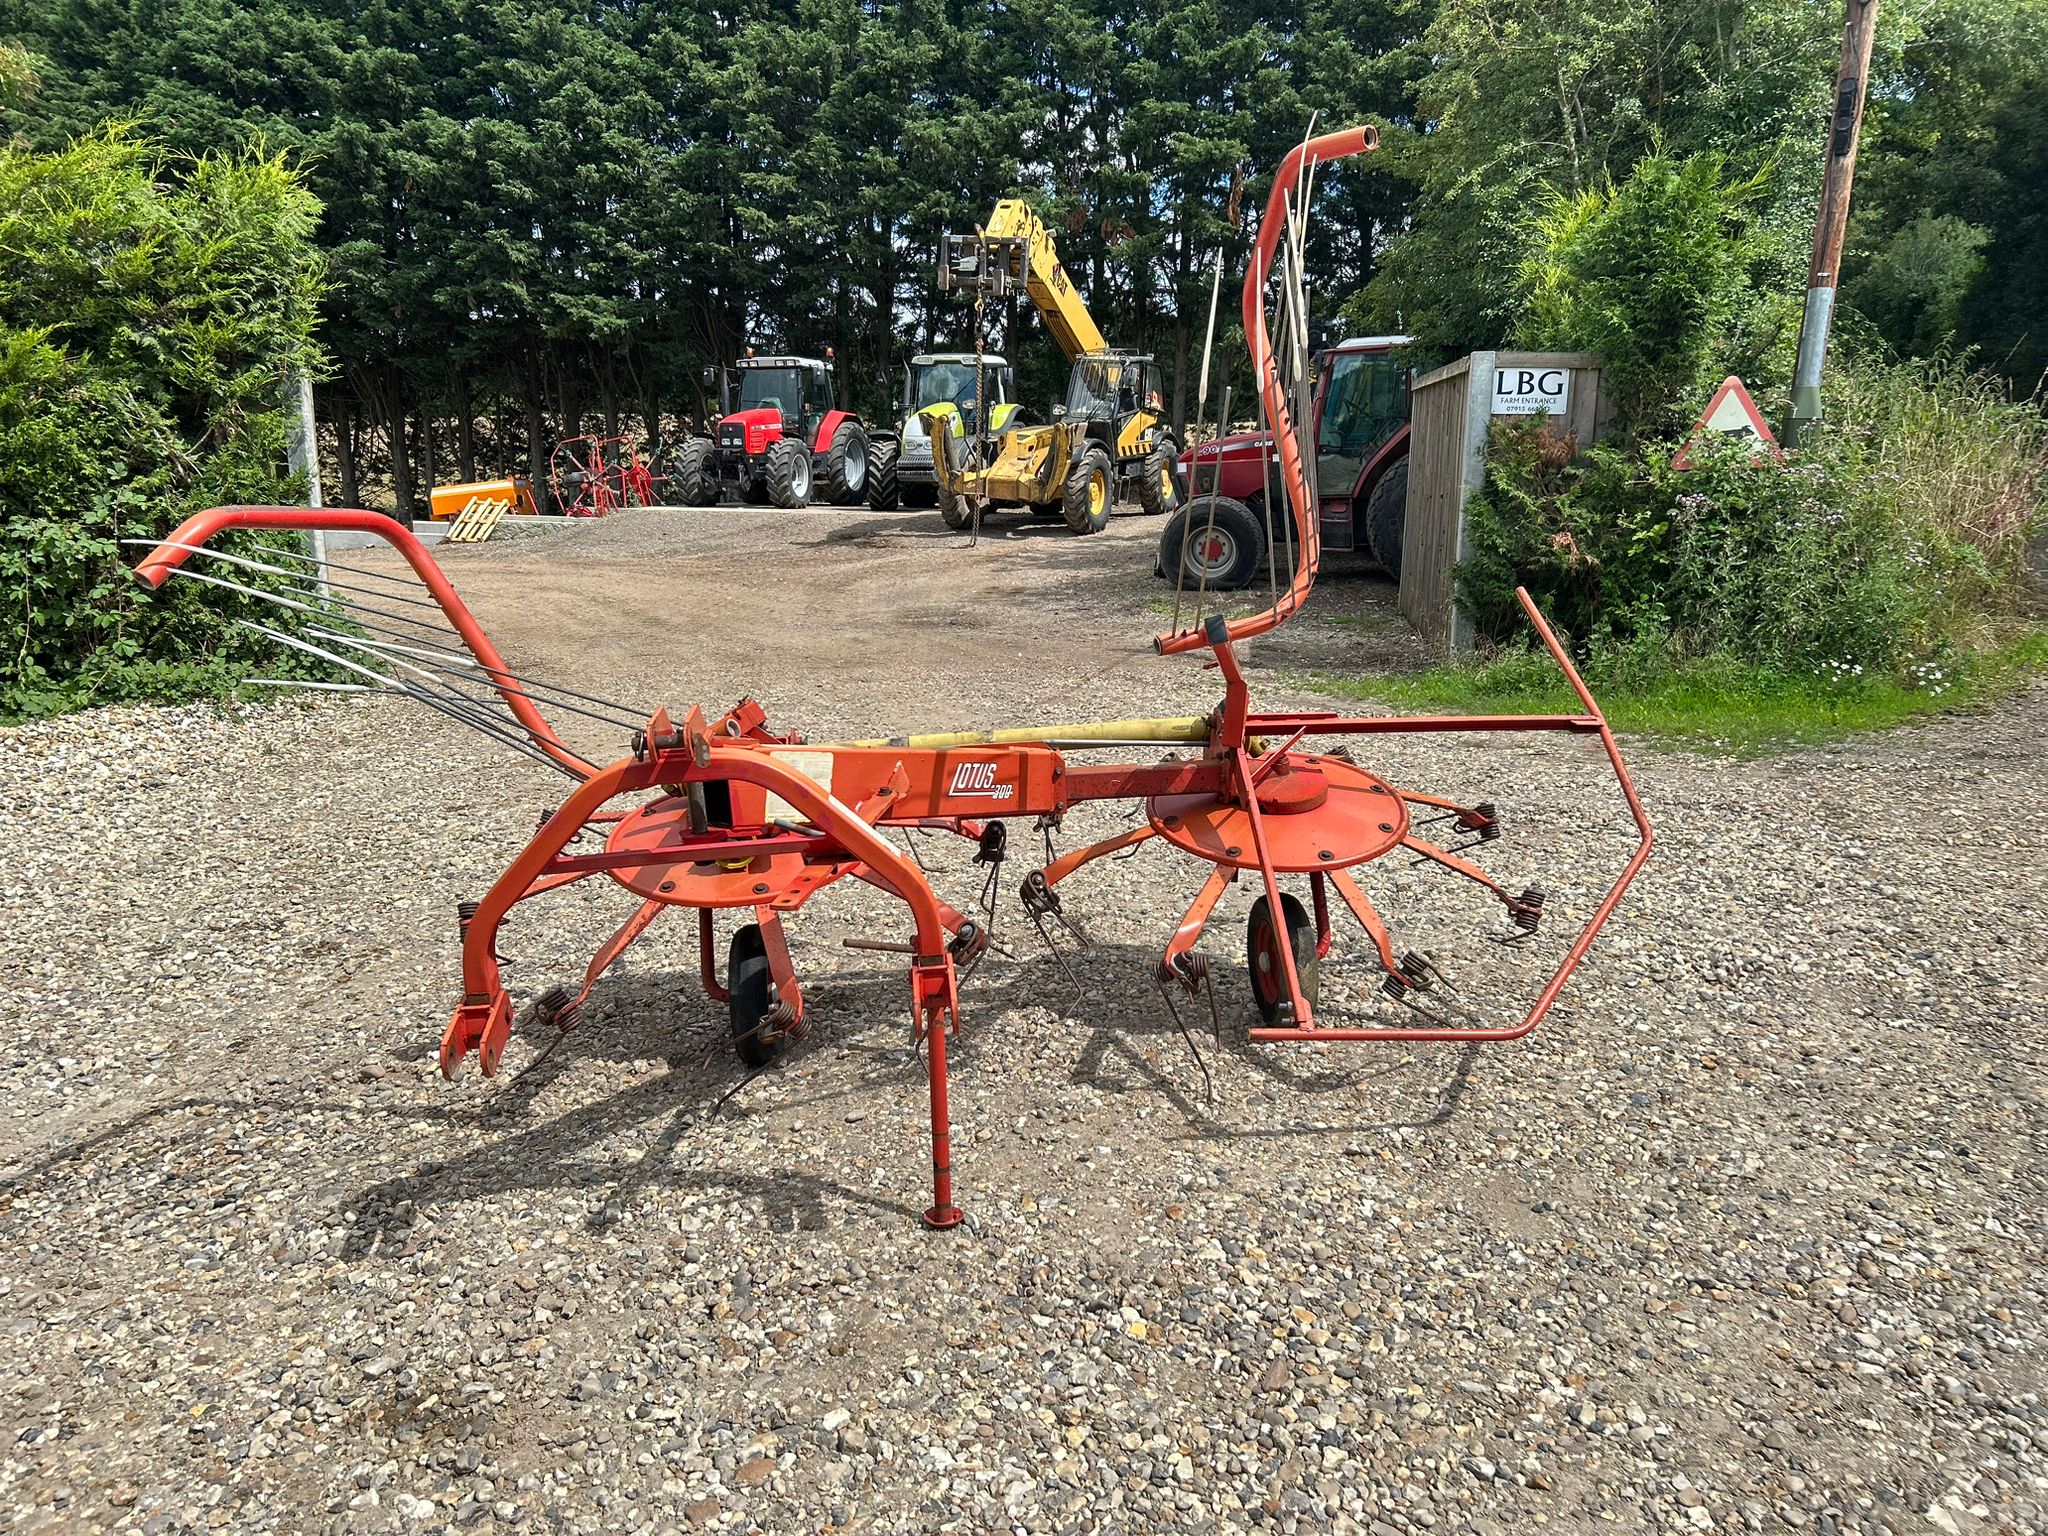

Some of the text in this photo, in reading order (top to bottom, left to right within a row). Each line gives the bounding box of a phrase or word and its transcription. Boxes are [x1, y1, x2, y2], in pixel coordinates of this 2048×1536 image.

[1496, 370, 1564, 396] LBG
[1521, 397, 1557, 405] ENTRANCE
[992, 784, 1013, 799] 300
